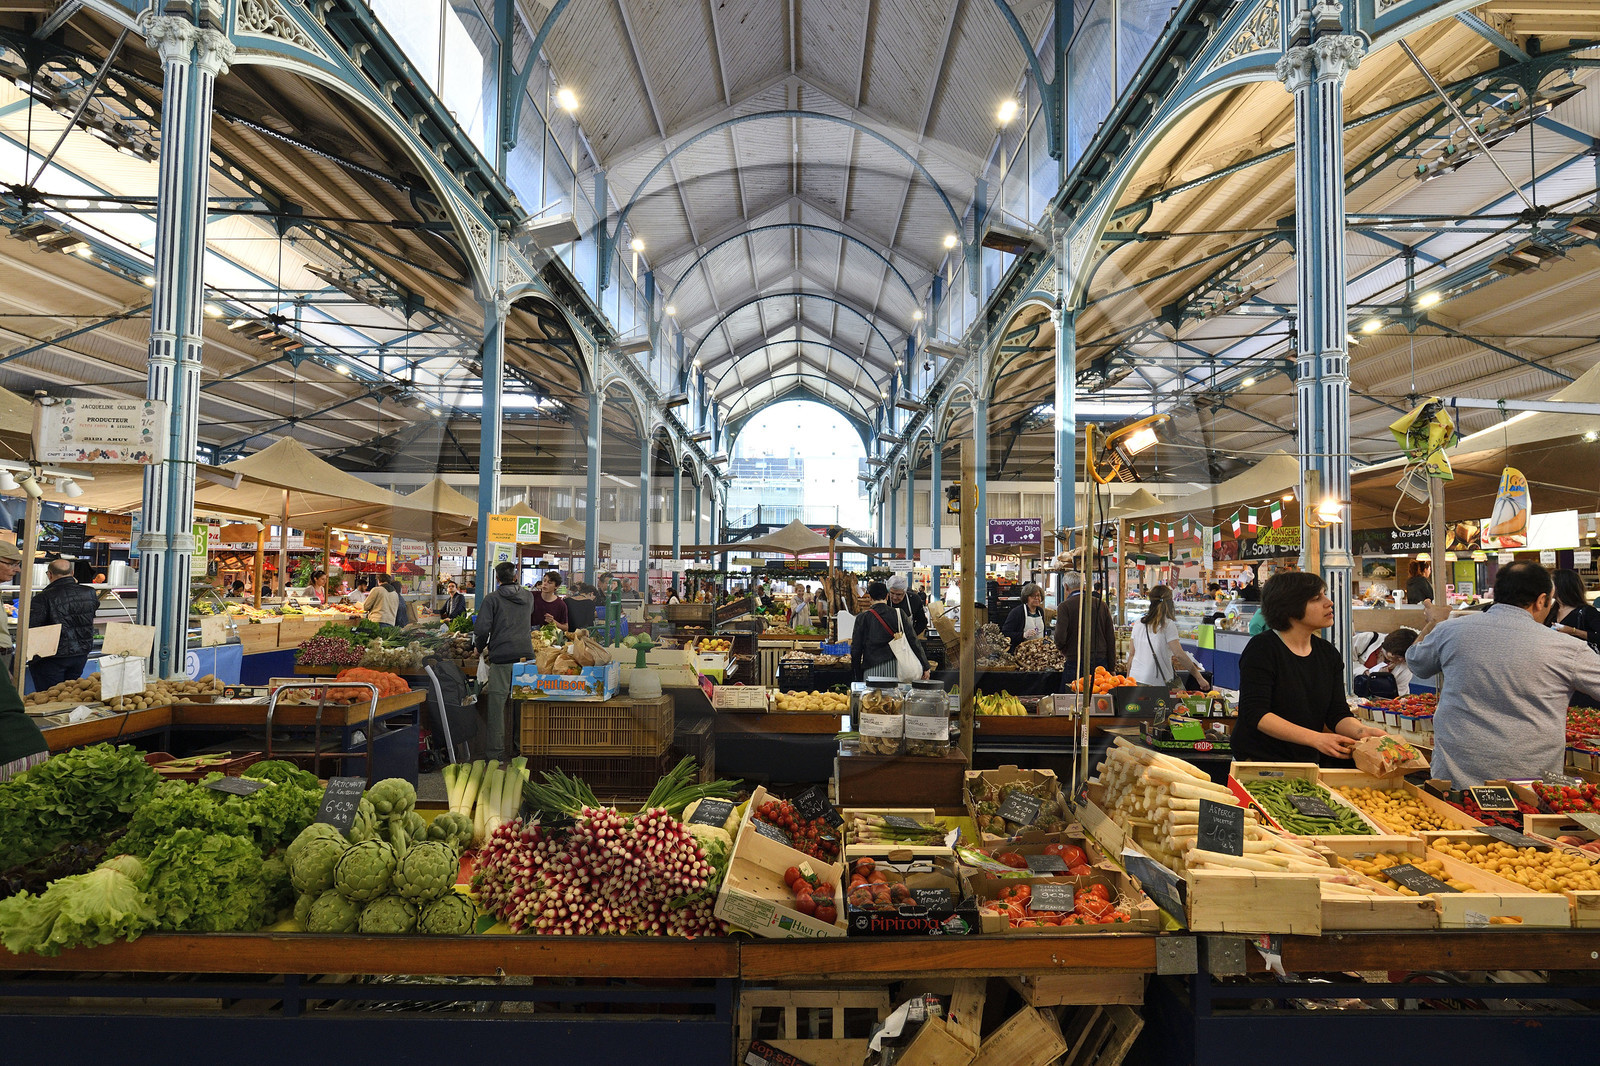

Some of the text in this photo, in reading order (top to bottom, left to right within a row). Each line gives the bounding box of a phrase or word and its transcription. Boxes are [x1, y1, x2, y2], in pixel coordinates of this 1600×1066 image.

[519, 522, 536, 534] AB
[990, 519, 1040, 527] Champignonnière
[1024, 525, 1041, 533] Dijon
[536, 679, 585, 691] PHILIBON
[1208, 804, 1236, 819] ASPERGE
[1039, 903, 1066, 911] FRANCE
